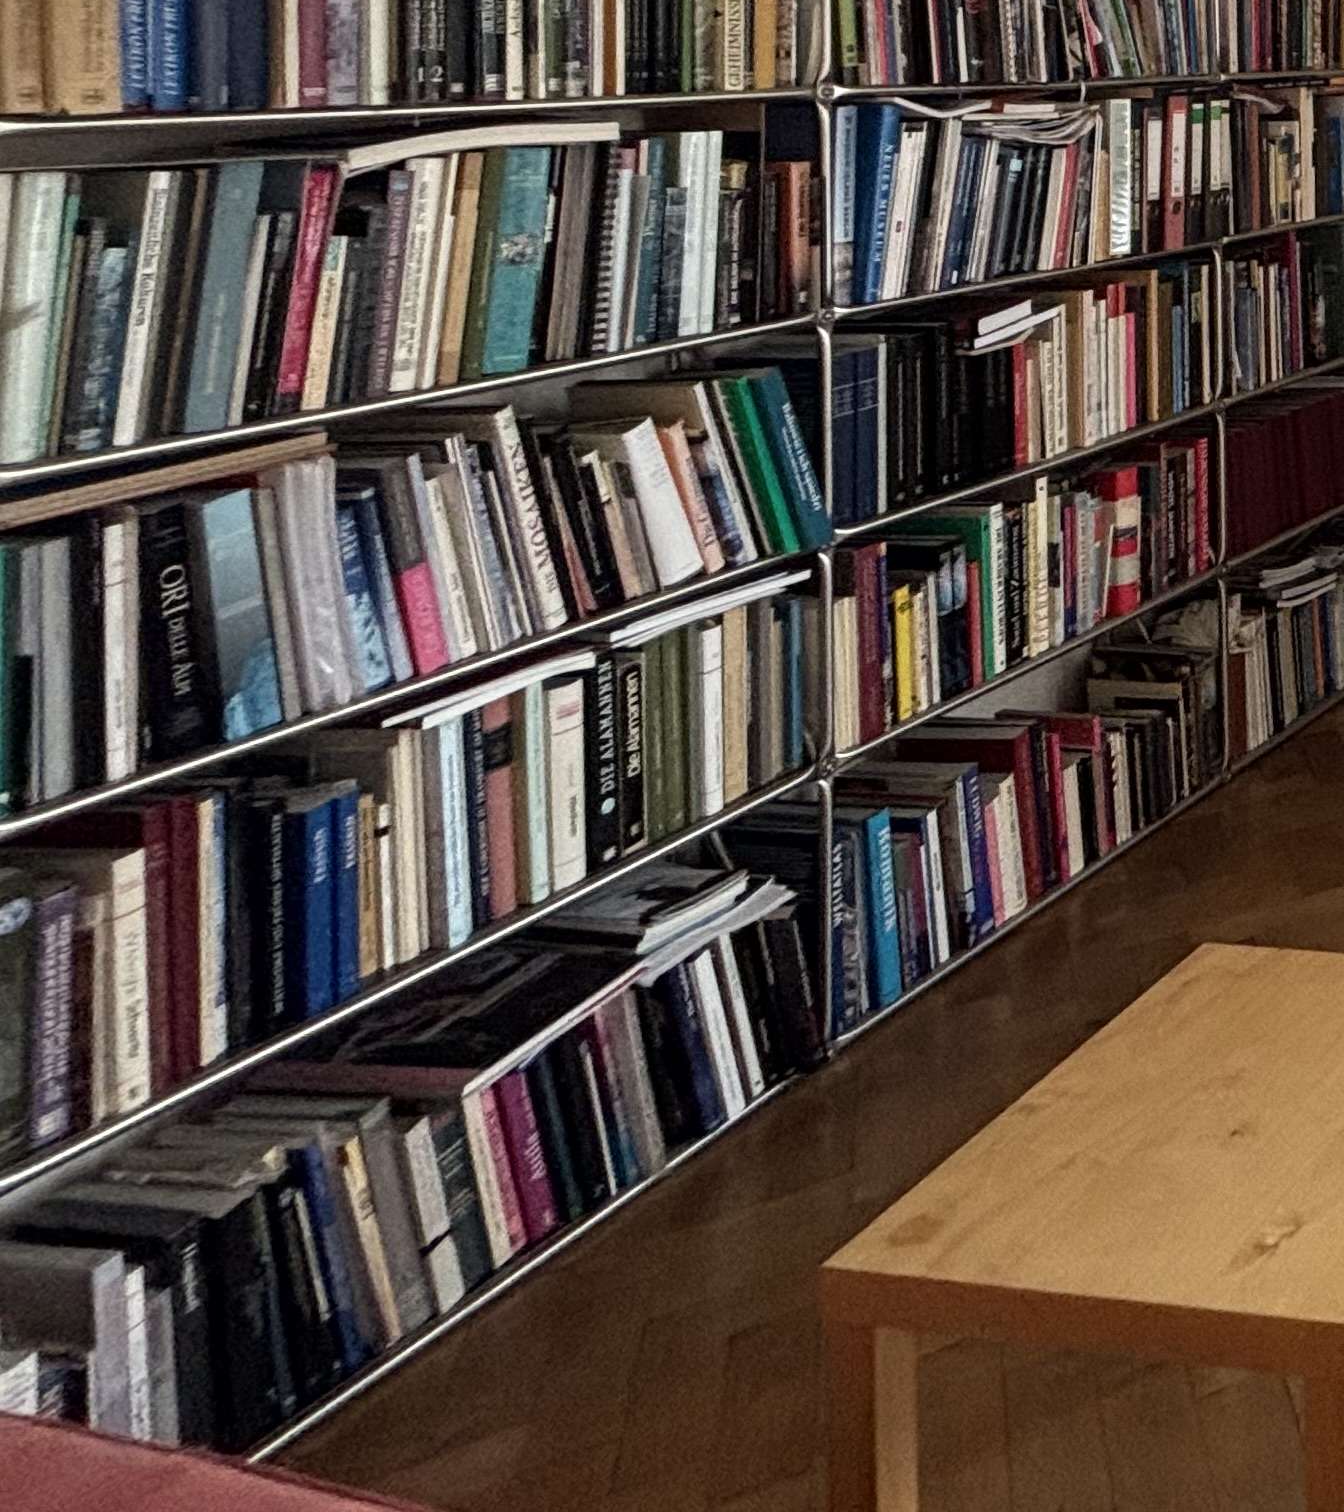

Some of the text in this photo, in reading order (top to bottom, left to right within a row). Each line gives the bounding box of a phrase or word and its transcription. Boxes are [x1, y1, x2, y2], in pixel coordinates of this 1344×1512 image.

[429, 65, 443, 83] 2
[872, 144, 894, 263] NEUES MUSEUM
[508, 442, 550, 570] MOSAIKEN
[159, 564, 191, 618] ORI
[598, 660, 616, 794] DIE ALAMANNEN
[625, 671, 642, 777] Die Alamannen
[878, 825, 896, 933] Romanik
